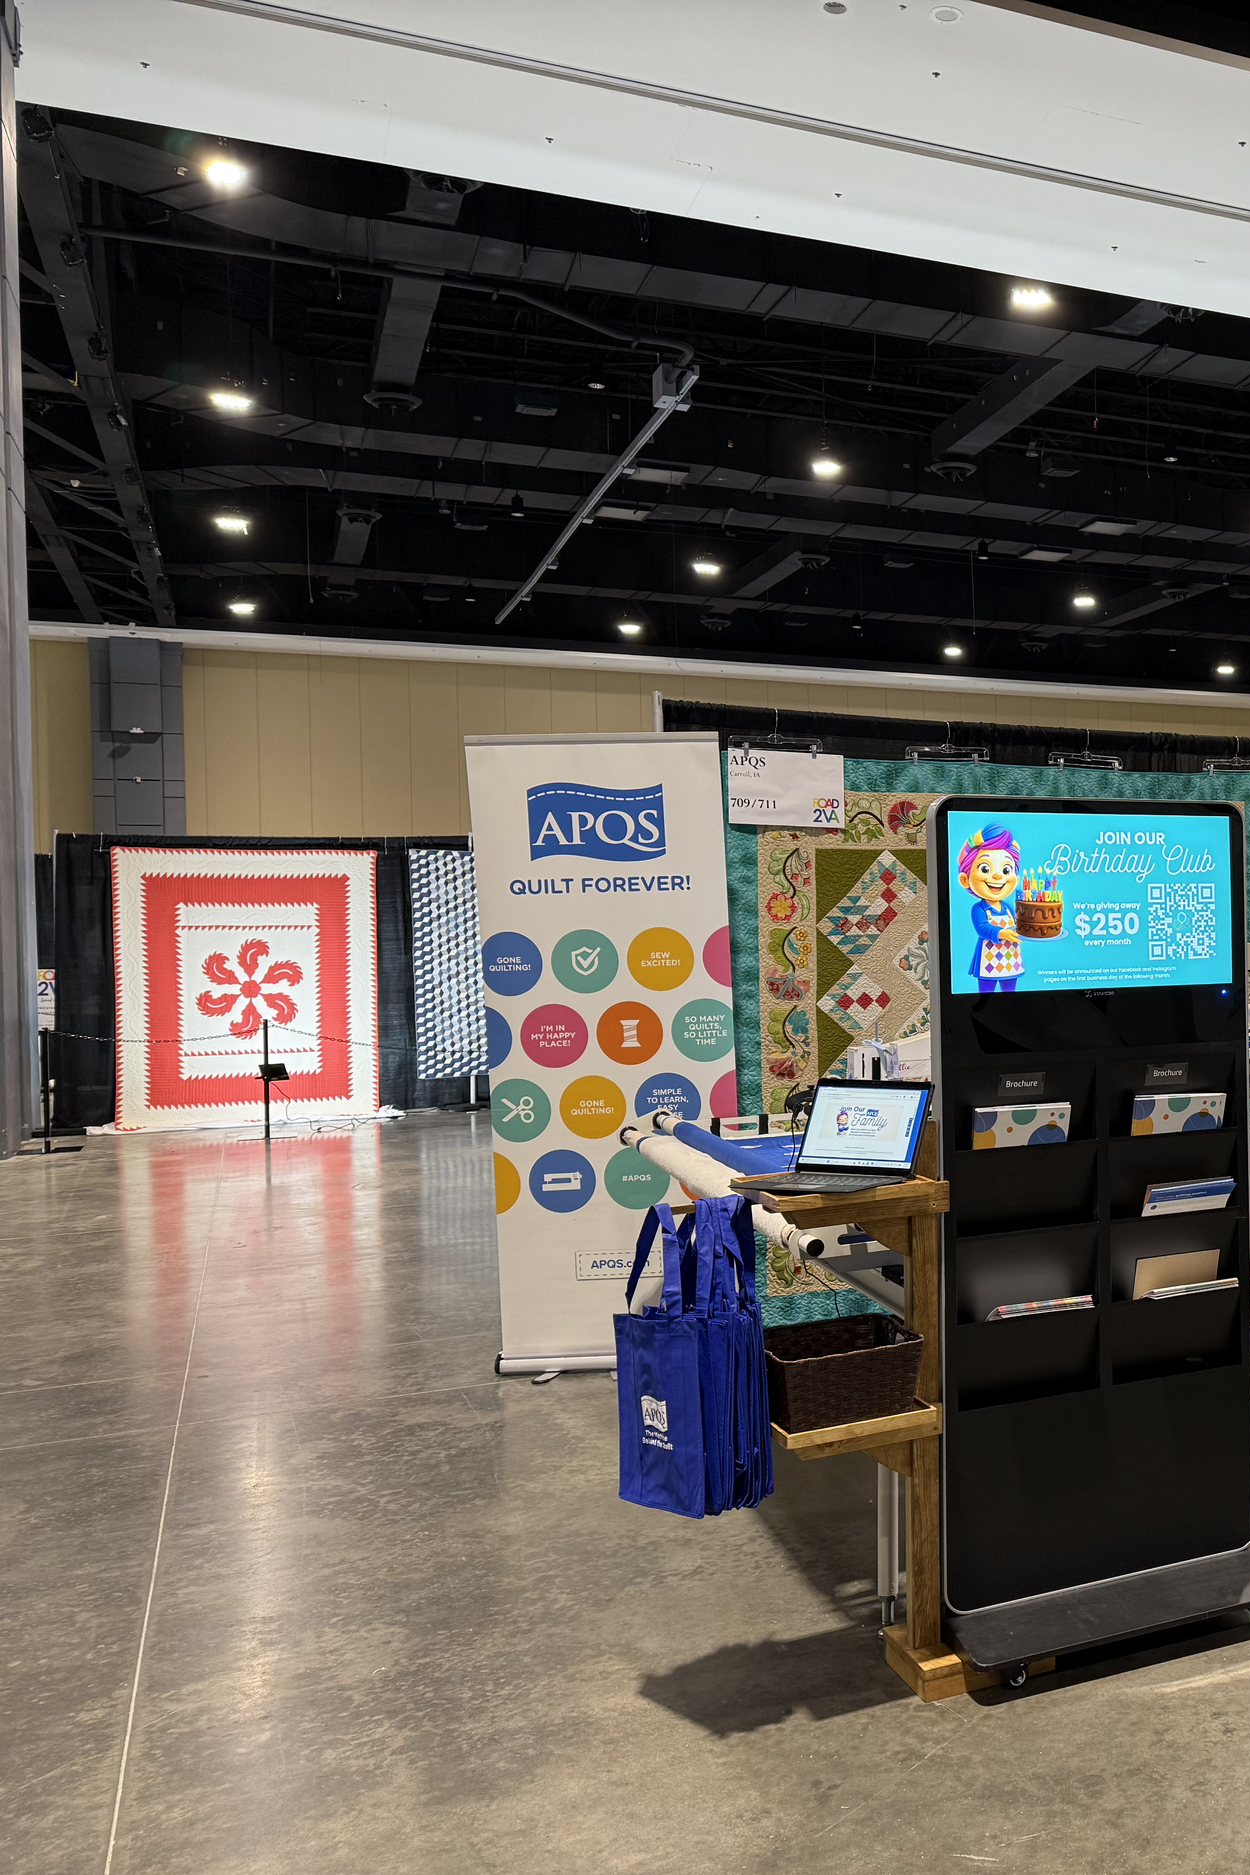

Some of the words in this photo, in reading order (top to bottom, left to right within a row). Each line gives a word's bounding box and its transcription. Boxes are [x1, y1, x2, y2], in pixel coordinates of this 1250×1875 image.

[730, 755, 766, 770] APQS
[730, 798, 776, 809] 709/711
[812, 798, 839, 808] ROAD
[812, 809, 840, 823] 2VA
[532, 809, 666, 852] APQS
[1096, 832, 1131, 845] JOIN
[1134, 832, 1165, 845] OUR
[1044, 843, 1155, 883] Birthday
[1162, 844, 1216, 875] Club
[509, 878, 574, 895] QUILT
[581, 875, 691, 893] FOREVER!
[1022, 876, 1057, 891] HAPPY
[1016, 890, 1063, 902] BIRTHDAY
[1073, 902, 1094, 910] We're
[1096, 902, 1119, 912] giving
[1120, 903, 1141, 912] away
[1074, 912, 1140, 938] $250
[1084, 939, 1103, 947] every
[1106, 938, 1131, 946] month
[641, 959, 681, 967] EXCITED!
[489, 964, 531, 972] QUILTING!
[699, 1014, 725, 1023] MANY
[689, 1022, 722, 1031] QUILTS,
[531, 1032, 544, 1040] MY
[546, 1032, 576, 1040] HAPPY
[683, 1031, 697, 1039] SO
[699, 1029, 728, 1038] LITTLE
[539, 1040, 571, 1048] PLACE!
[696, 1037, 717, 1046] TIME
[1153, 1068, 1182, 1077] Brochure
[1005, 1079, 1038, 1088] Brochure
[652, 1088, 682, 1096] SIMPLE
[646, 1096, 658, 1104] TO
[660, 1095, 689, 1104] LEARN,
[571, 1106, 614, 1115] QUILTING!
[657, 1104, 679, 1112] EASY
[851, 1113, 888, 1131] Family
[622, 1174, 652, 1182] #APQS
[644, 1408, 666, 1429] APQS
